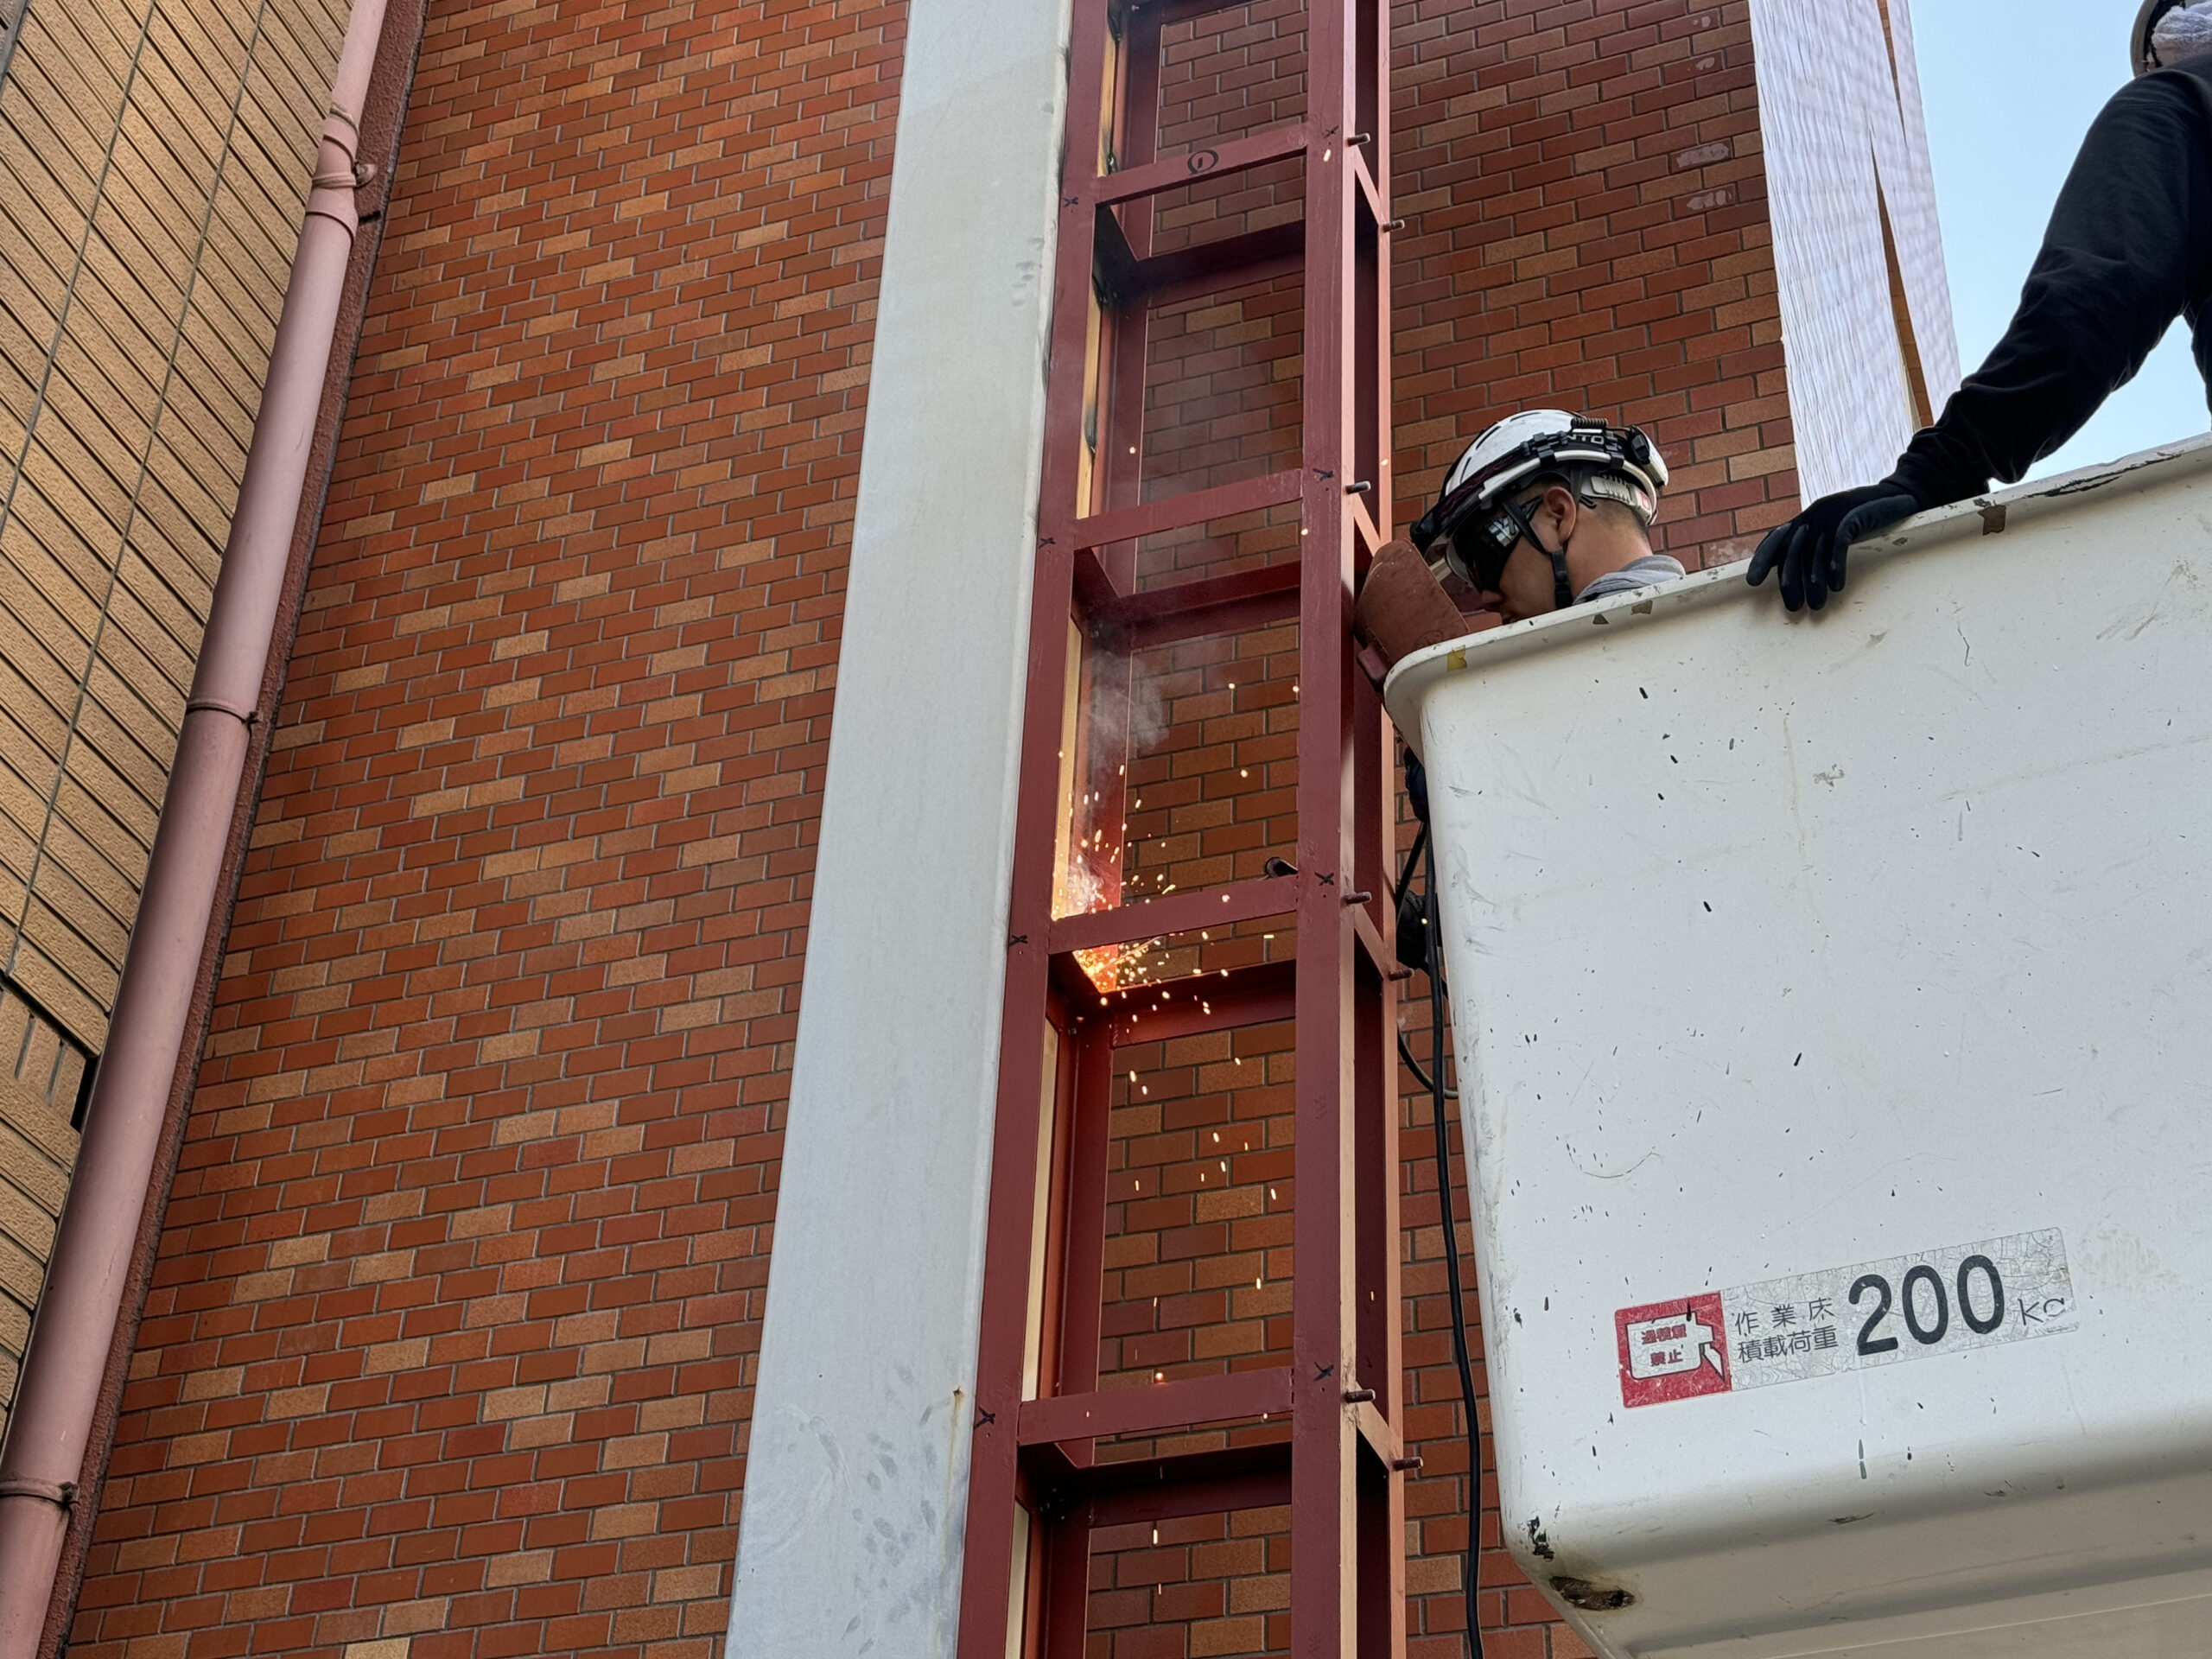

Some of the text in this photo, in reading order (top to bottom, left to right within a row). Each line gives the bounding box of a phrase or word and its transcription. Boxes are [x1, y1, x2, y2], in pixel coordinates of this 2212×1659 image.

[1735, 1297, 1835, 1336] 作業床
[1848, 1255, 2005, 1356] 200
[1649, 1349, 1684, 1367] 禁止
[1738, 1325, 1839, 1363] 積載荷重
